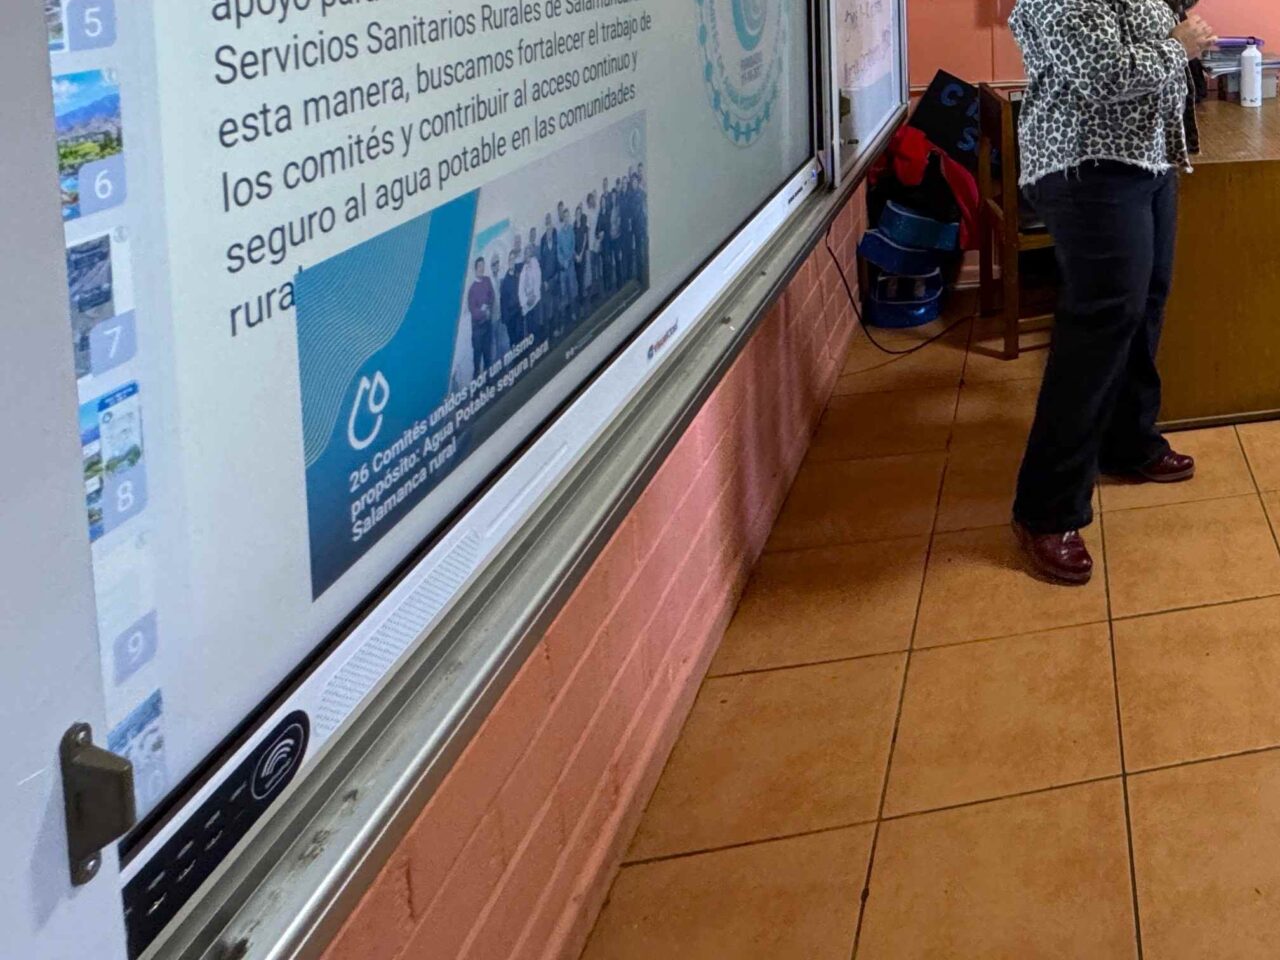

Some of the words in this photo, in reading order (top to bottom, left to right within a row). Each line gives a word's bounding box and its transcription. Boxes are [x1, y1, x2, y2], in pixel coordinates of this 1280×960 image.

[83, 6, 103, 37] 5
[214, 30, 359, 85] Servicios
[366, 10, 476, 54] Sanitarios
[218, 102, 292, 149] esta
[303, 75, 409, 126] manera,
[416, 47, 514, 95] buscamos
[518, 30, 585, 66] fortalecer
[588, 22, 599, 47] el
[601, 17, 638, 44] trabajo
[640, 10, 652, 32] de
[222, 169, 273, 213] los
[283, 125, 395, 190] comités
[400, 122, 413, 157] y
[418, 88, 509, 142] contribuir
[513, 79, 527, 109] al
[532, 68, 580, 102] acceso
[582, 54, 630, 85] continuo
[630, 49, 638, 72] y
[94, 169, 113, 200] 6
[226, 205, 336, 275] seguro
[345, 182, 367, 224] al
[375, 166, 431, 211] agua
[438, 132, 506, 191] potable
[511, 124, 531, 152] en
[535, 115, 556, 141] las
[559, 82, 635, 131] comunidades
[229, 272, 300, 338] rura
[103, 328, 123, 360] 7
[350, 463, 370, 493] 26
[372, 421, 427, 473] Comités
[429, 390, 468, 426] unidos
[470, 373, 487, 400] por
[489, 361, 502, 379] un
[503, 333, 535, 369] mismo
[351, 449, 421, 523] propósito:
[422, 420, 454, 457] Agua
[455, 389, 495, 428] Potable
[497, 359, 528, 394] segura
[530, 340, 550, 370] para
[115, 478, 134, 512] 8
[352, 469, 428, 541] Salamanca
[429, 436, 457, 474] rural
[125, 630, 143, 663] 9
